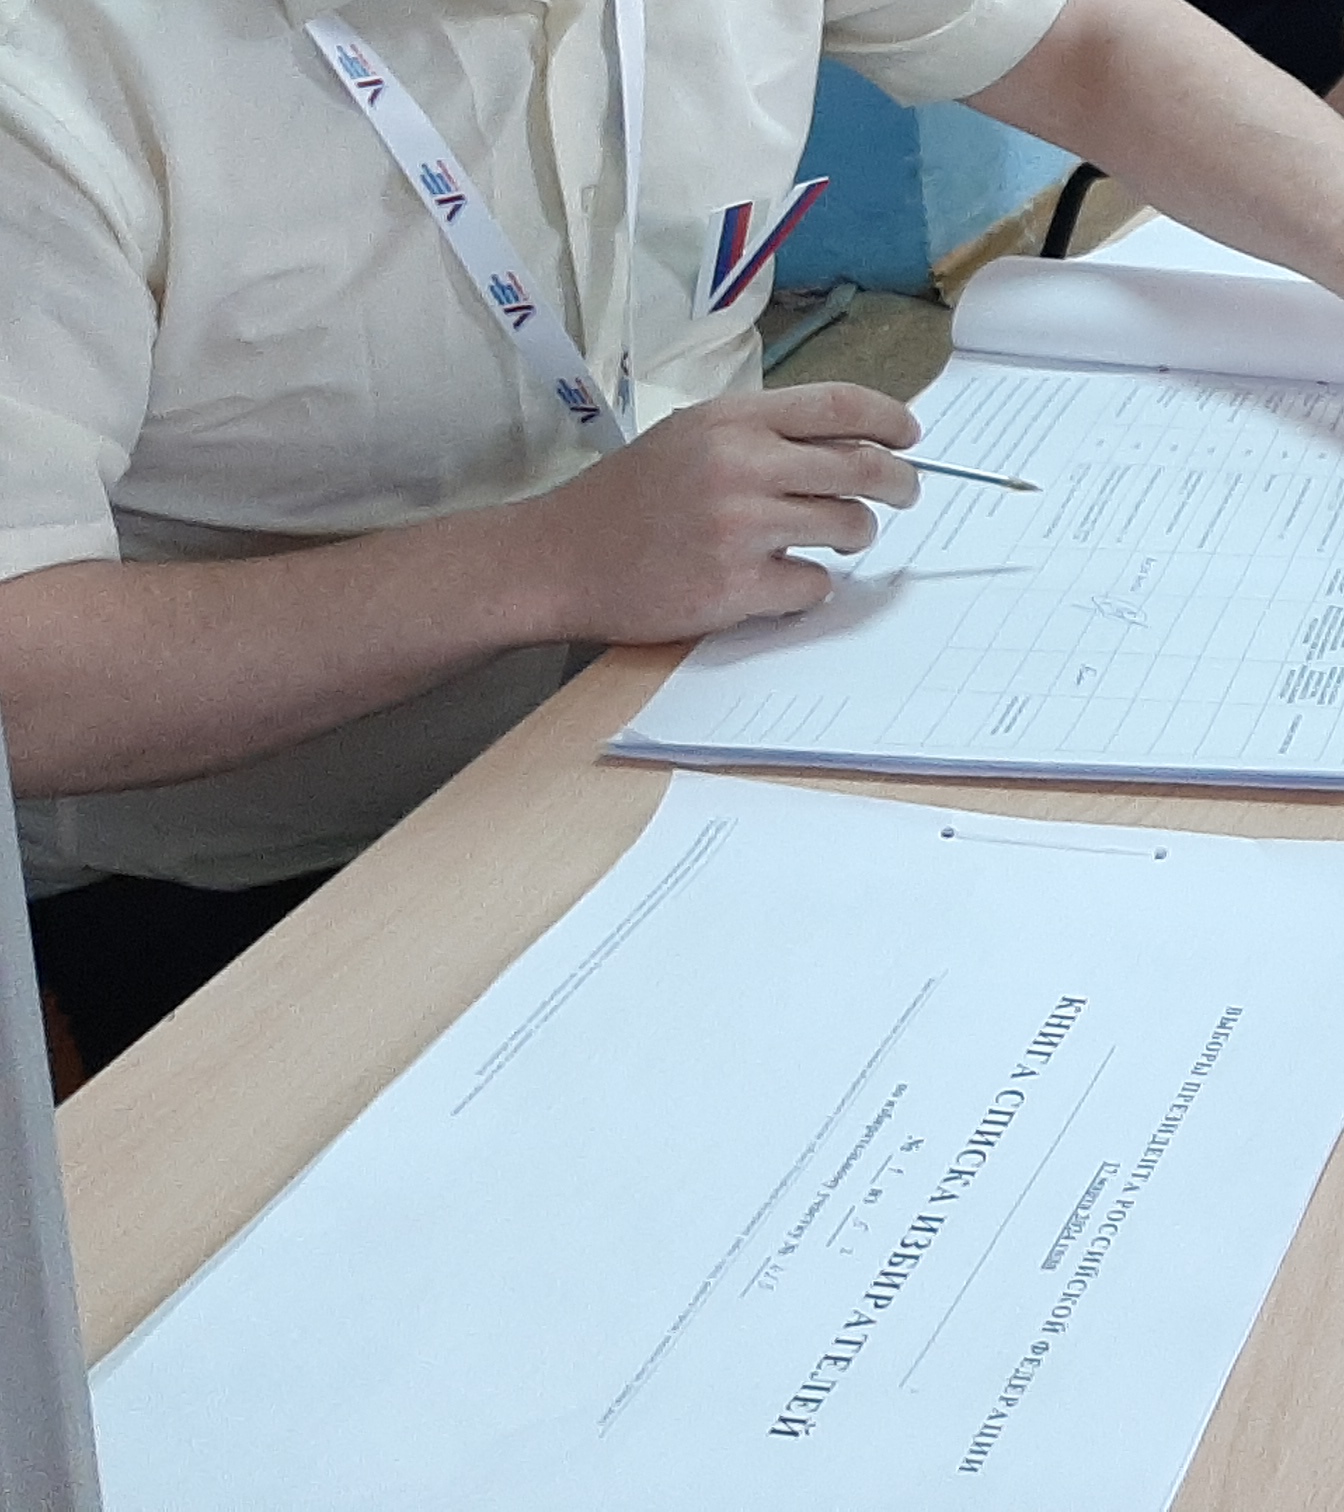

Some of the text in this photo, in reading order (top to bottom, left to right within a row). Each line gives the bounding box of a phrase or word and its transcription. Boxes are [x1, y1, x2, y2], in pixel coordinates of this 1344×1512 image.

[1010, 993, 1090, 1081] КНИГА
[928, 1088, 1026, 1204] СПИСКА
[958, 1005, 1243, 1475] ВЫБОРЫ ПРЕЗИДЕНТА РОССИЙСКОЙ ФЕДЕРАЦИИ
[767, 1213, 948, 1439] ИЗБИРАТЕЛЕЙ
